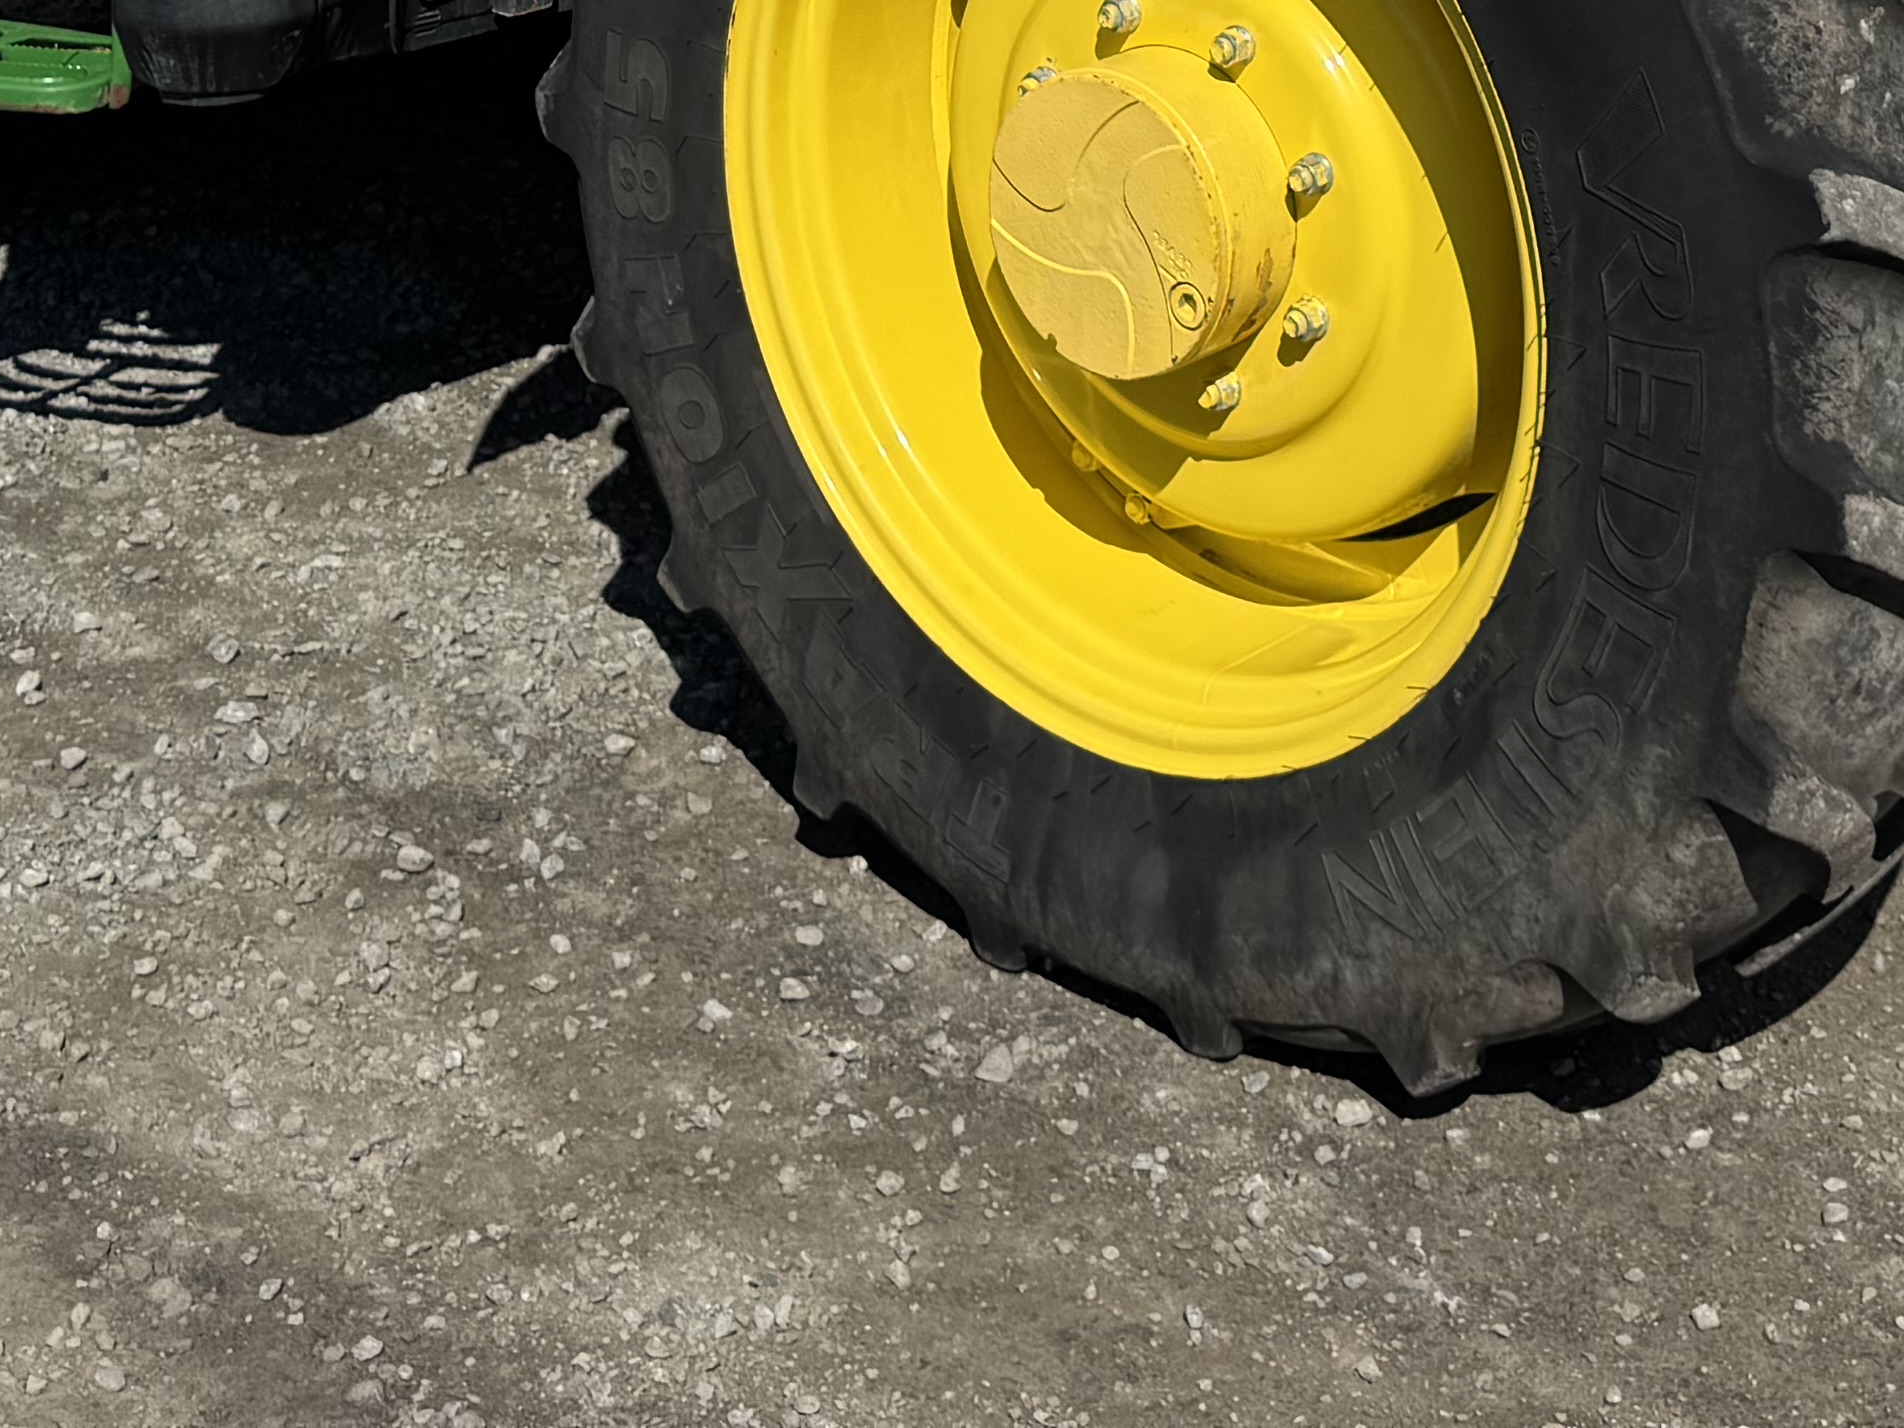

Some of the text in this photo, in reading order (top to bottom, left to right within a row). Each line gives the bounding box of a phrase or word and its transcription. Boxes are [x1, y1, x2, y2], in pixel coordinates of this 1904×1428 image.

[602, 26, 1011, 886] TRAXION 85
[1320, 65, 1706, 941] VREDESTEIN
